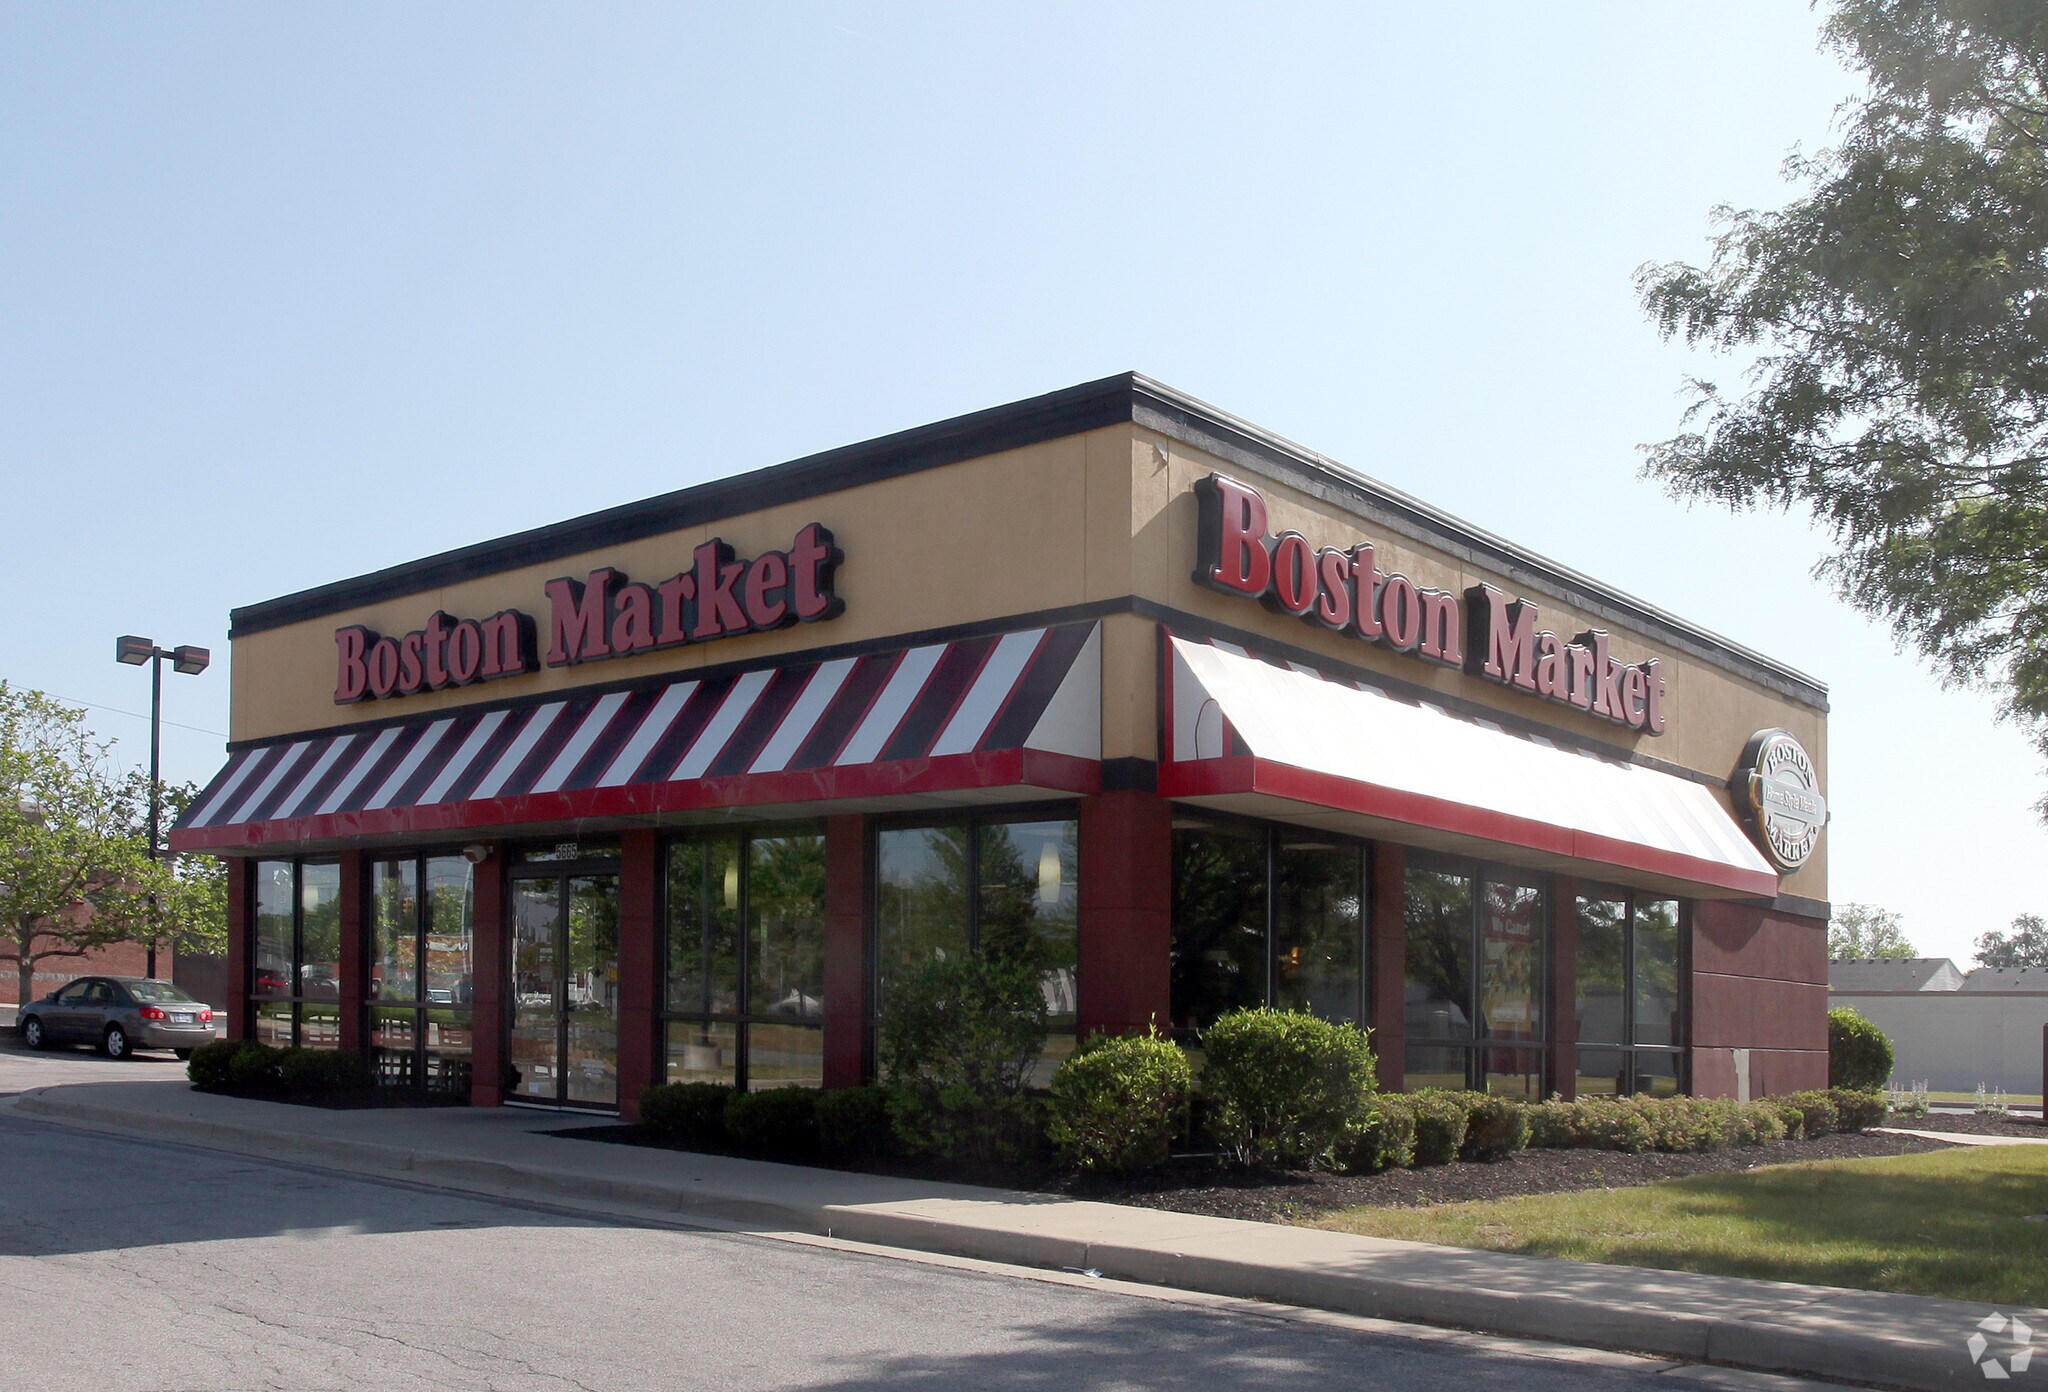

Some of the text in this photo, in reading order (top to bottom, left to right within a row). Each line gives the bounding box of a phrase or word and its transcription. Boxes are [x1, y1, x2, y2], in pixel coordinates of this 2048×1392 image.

[335, 523, 828, 700] Boston Market
[1214, 474, 1666, 736] Boston Market
[1768, 743, 1813, 786] BOSTON
[556, 844, 577, 859] 5665
[1766, 826, 1814, 861] MARKET
[1491, 916, 1504, 932] We
